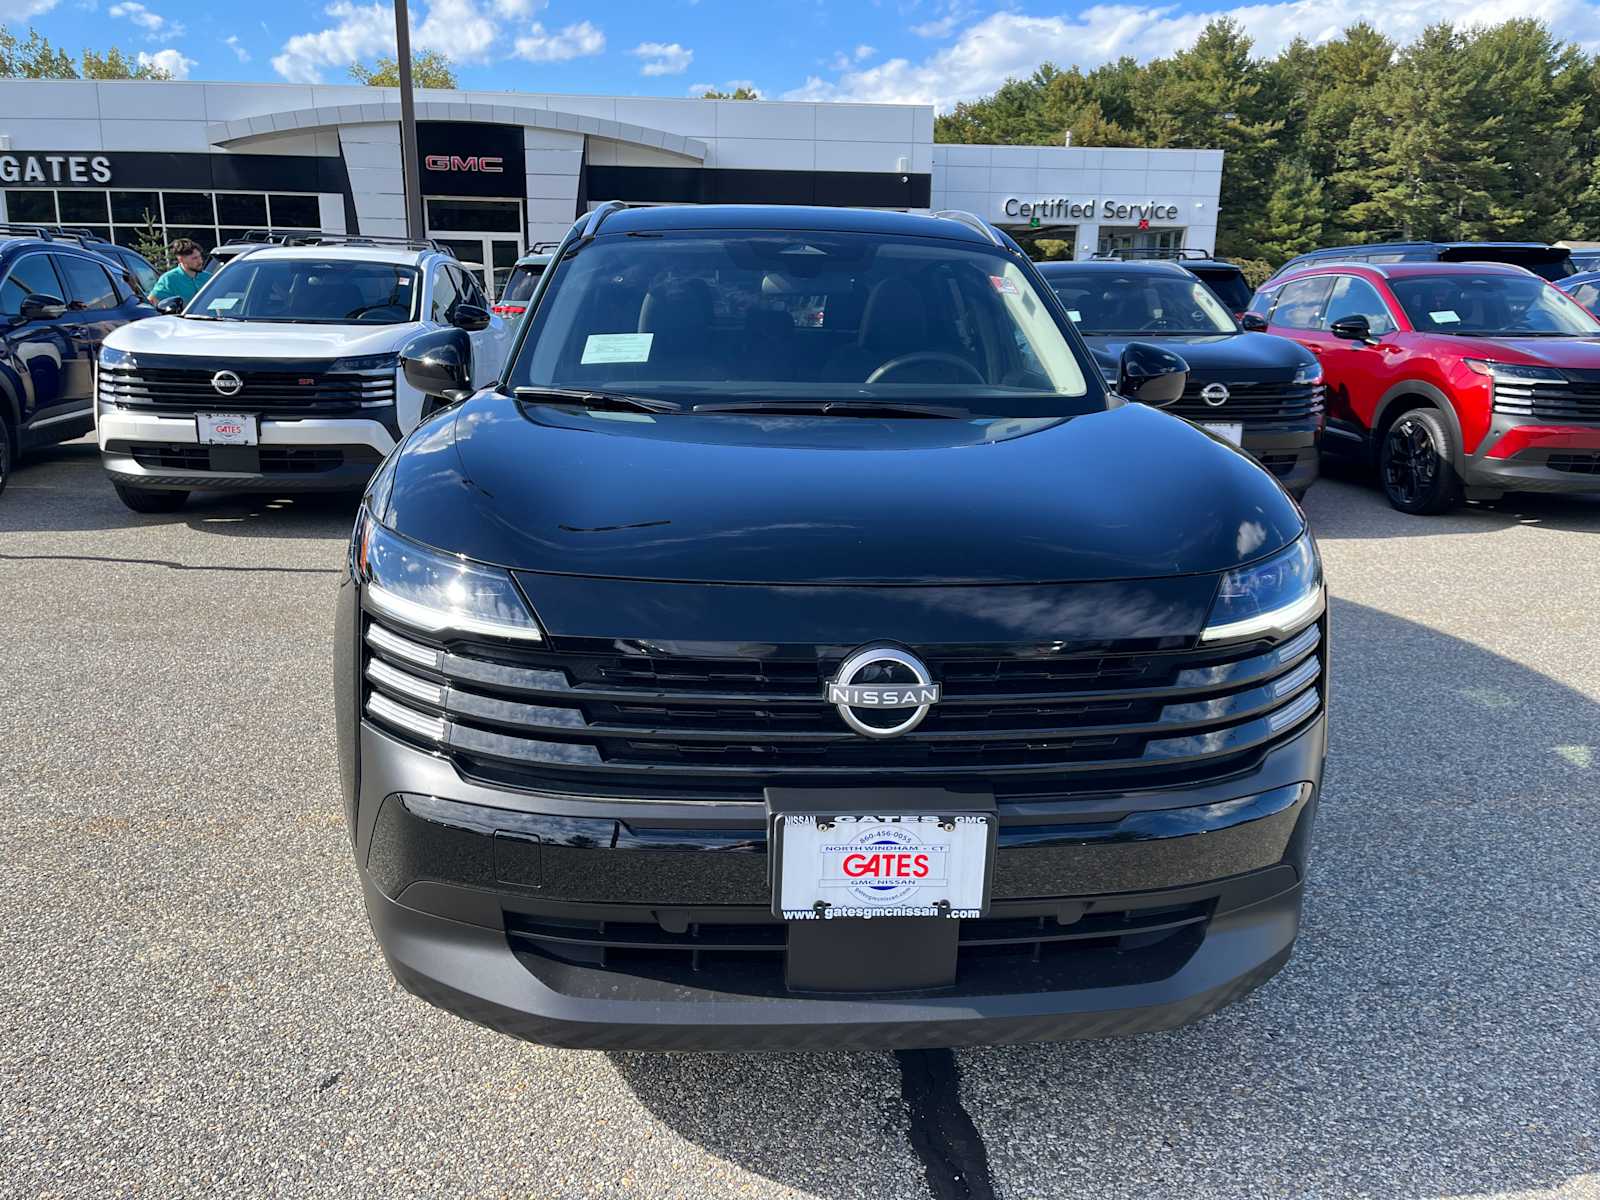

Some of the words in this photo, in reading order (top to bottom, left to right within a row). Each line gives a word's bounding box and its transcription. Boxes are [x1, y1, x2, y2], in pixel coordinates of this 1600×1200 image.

[0, 155, 112, 183] GATES
[425, 155, 503, 173] GMC
[1004, 198, 1095, 218] Certified
[1103, 200, 1178, 220] Service
[215, 425, 242, 434] GATES
[832, 688, 937, 705] NISSAN
[784, 815, 817, 825] NISSAN
[834, 815, 940, 823] GATES
[954, 816, 987, 824] GMC
[842, 853, 929, 878] GATES
[782, 910, 820, 920] www.
[824, 905, 938, 919] gatesgmcnissan
[946, 909, 980, 919] .com
